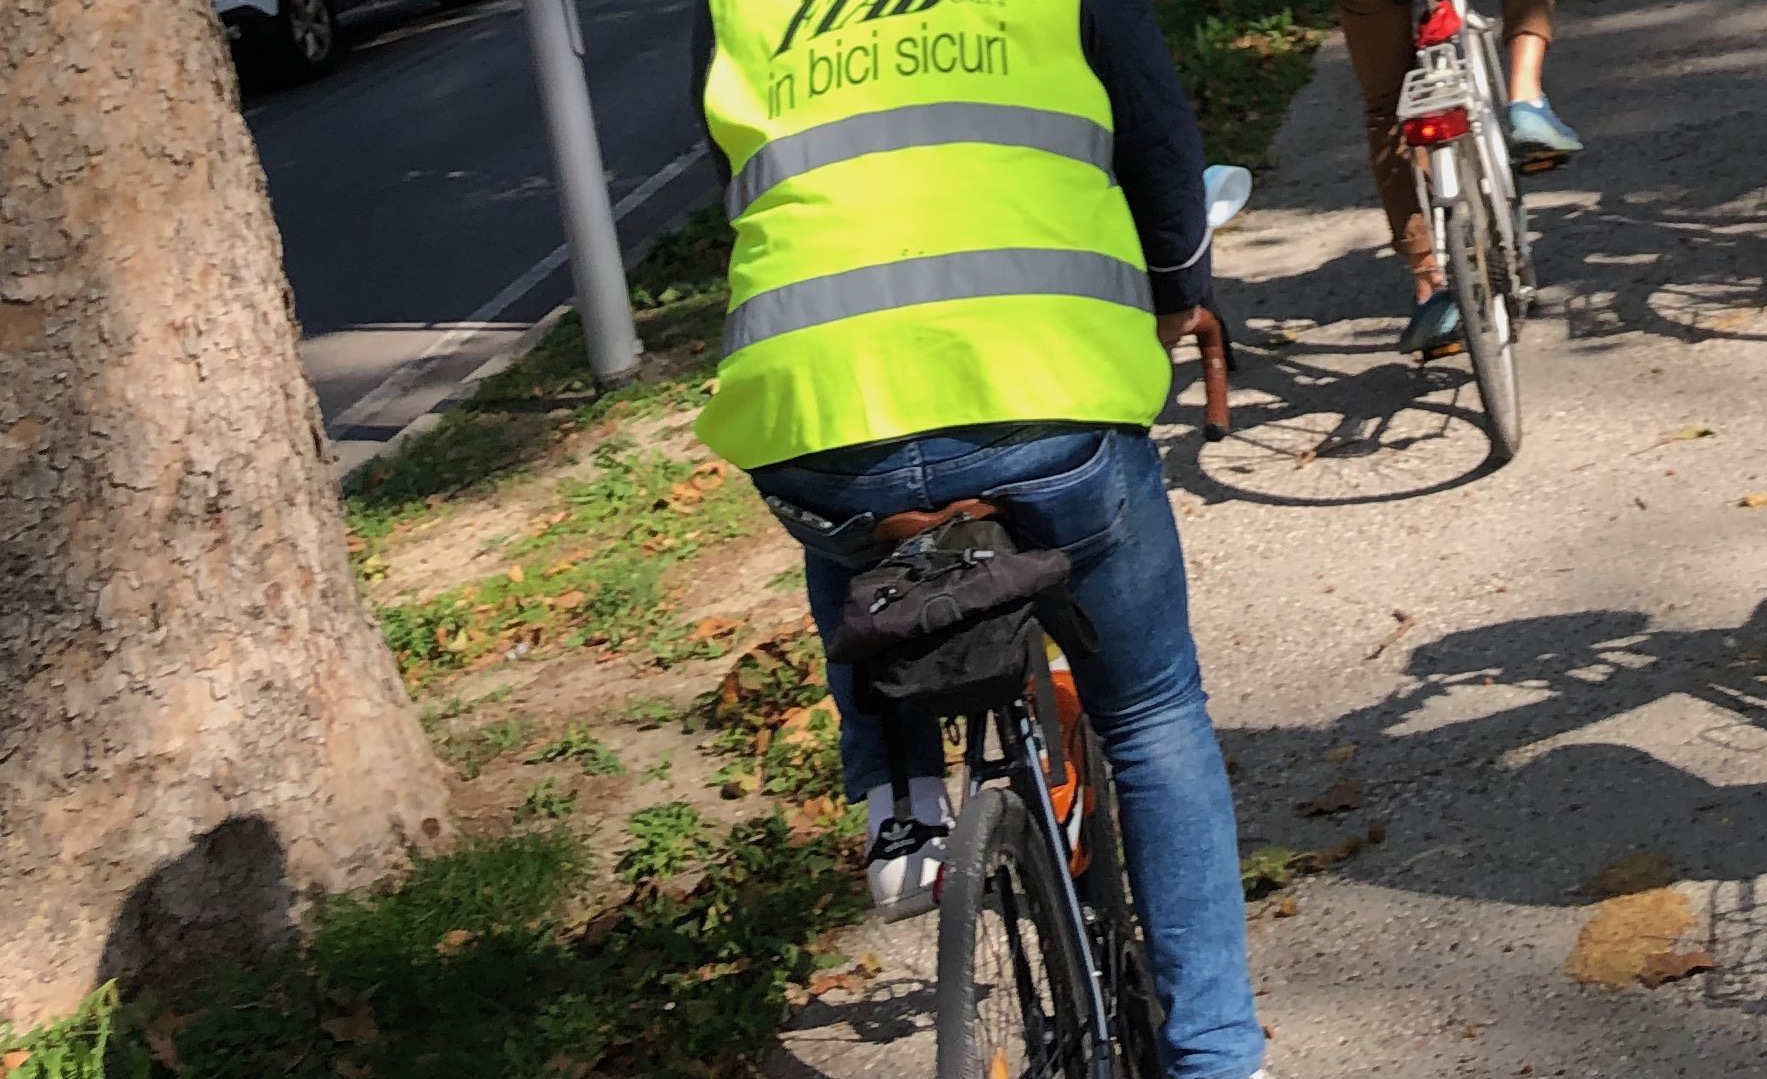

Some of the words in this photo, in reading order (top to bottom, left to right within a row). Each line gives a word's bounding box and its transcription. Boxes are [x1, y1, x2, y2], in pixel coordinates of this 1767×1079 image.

[768, 72, 796, 120] in
[809, 30, 878, 98] bici
[895, 21, 1009, 75] sicuri
